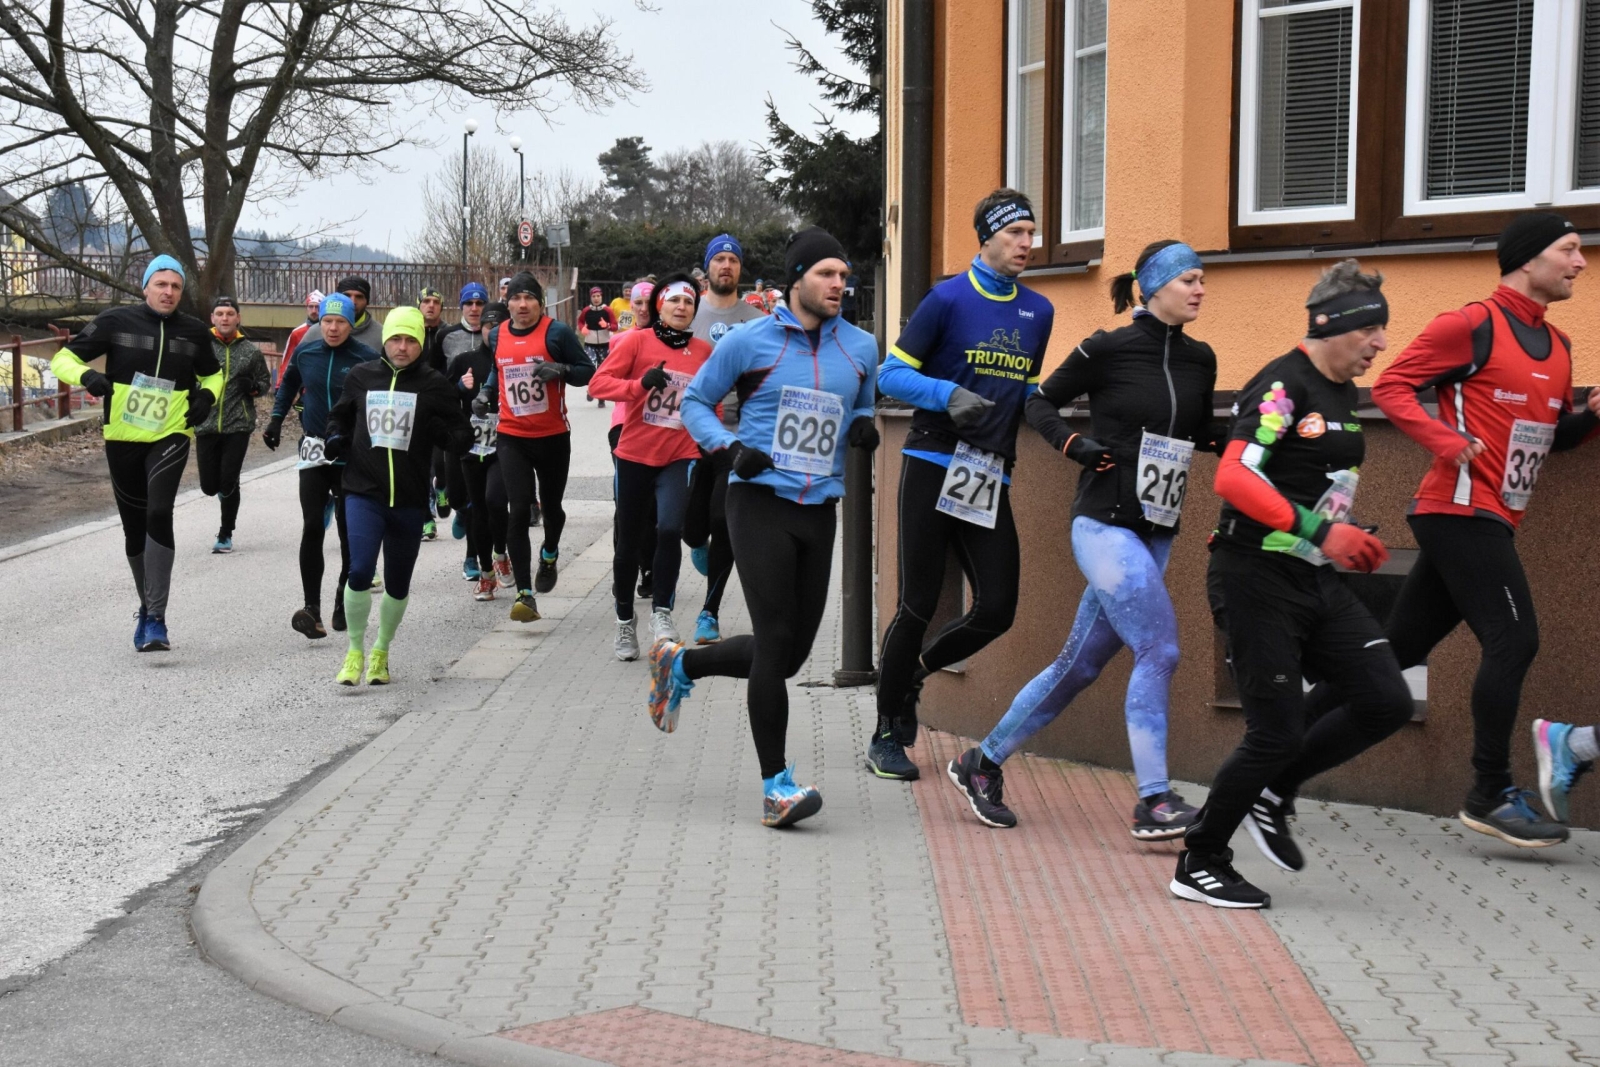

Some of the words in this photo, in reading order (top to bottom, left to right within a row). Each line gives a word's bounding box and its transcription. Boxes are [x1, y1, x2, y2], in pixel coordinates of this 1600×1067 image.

[964, 349, 1033, 372] TRUTNOV
[974, 367, 1006, 378] TRIATLON
[1006, 371, 1025, 381] TEAM
[127, 389, 169, 421] 673
[398, 400, 414, 408] LIGA
[508, 378, 545, 406] 163
[648, 386, 681, 416] 64
[783, 389, 811, 401] ZIMNÍ
[368, 408, 411, 437] 664
[821, 405, 841, 416] LIGA
[777, 412, 837, 457] 628
[1144, 437, 1170, 450] ZIMNÍ
[301, 439, 328, 463] 66
[946, 465, 997, 511] 271
[1140, 463, 1187, 509] 213
